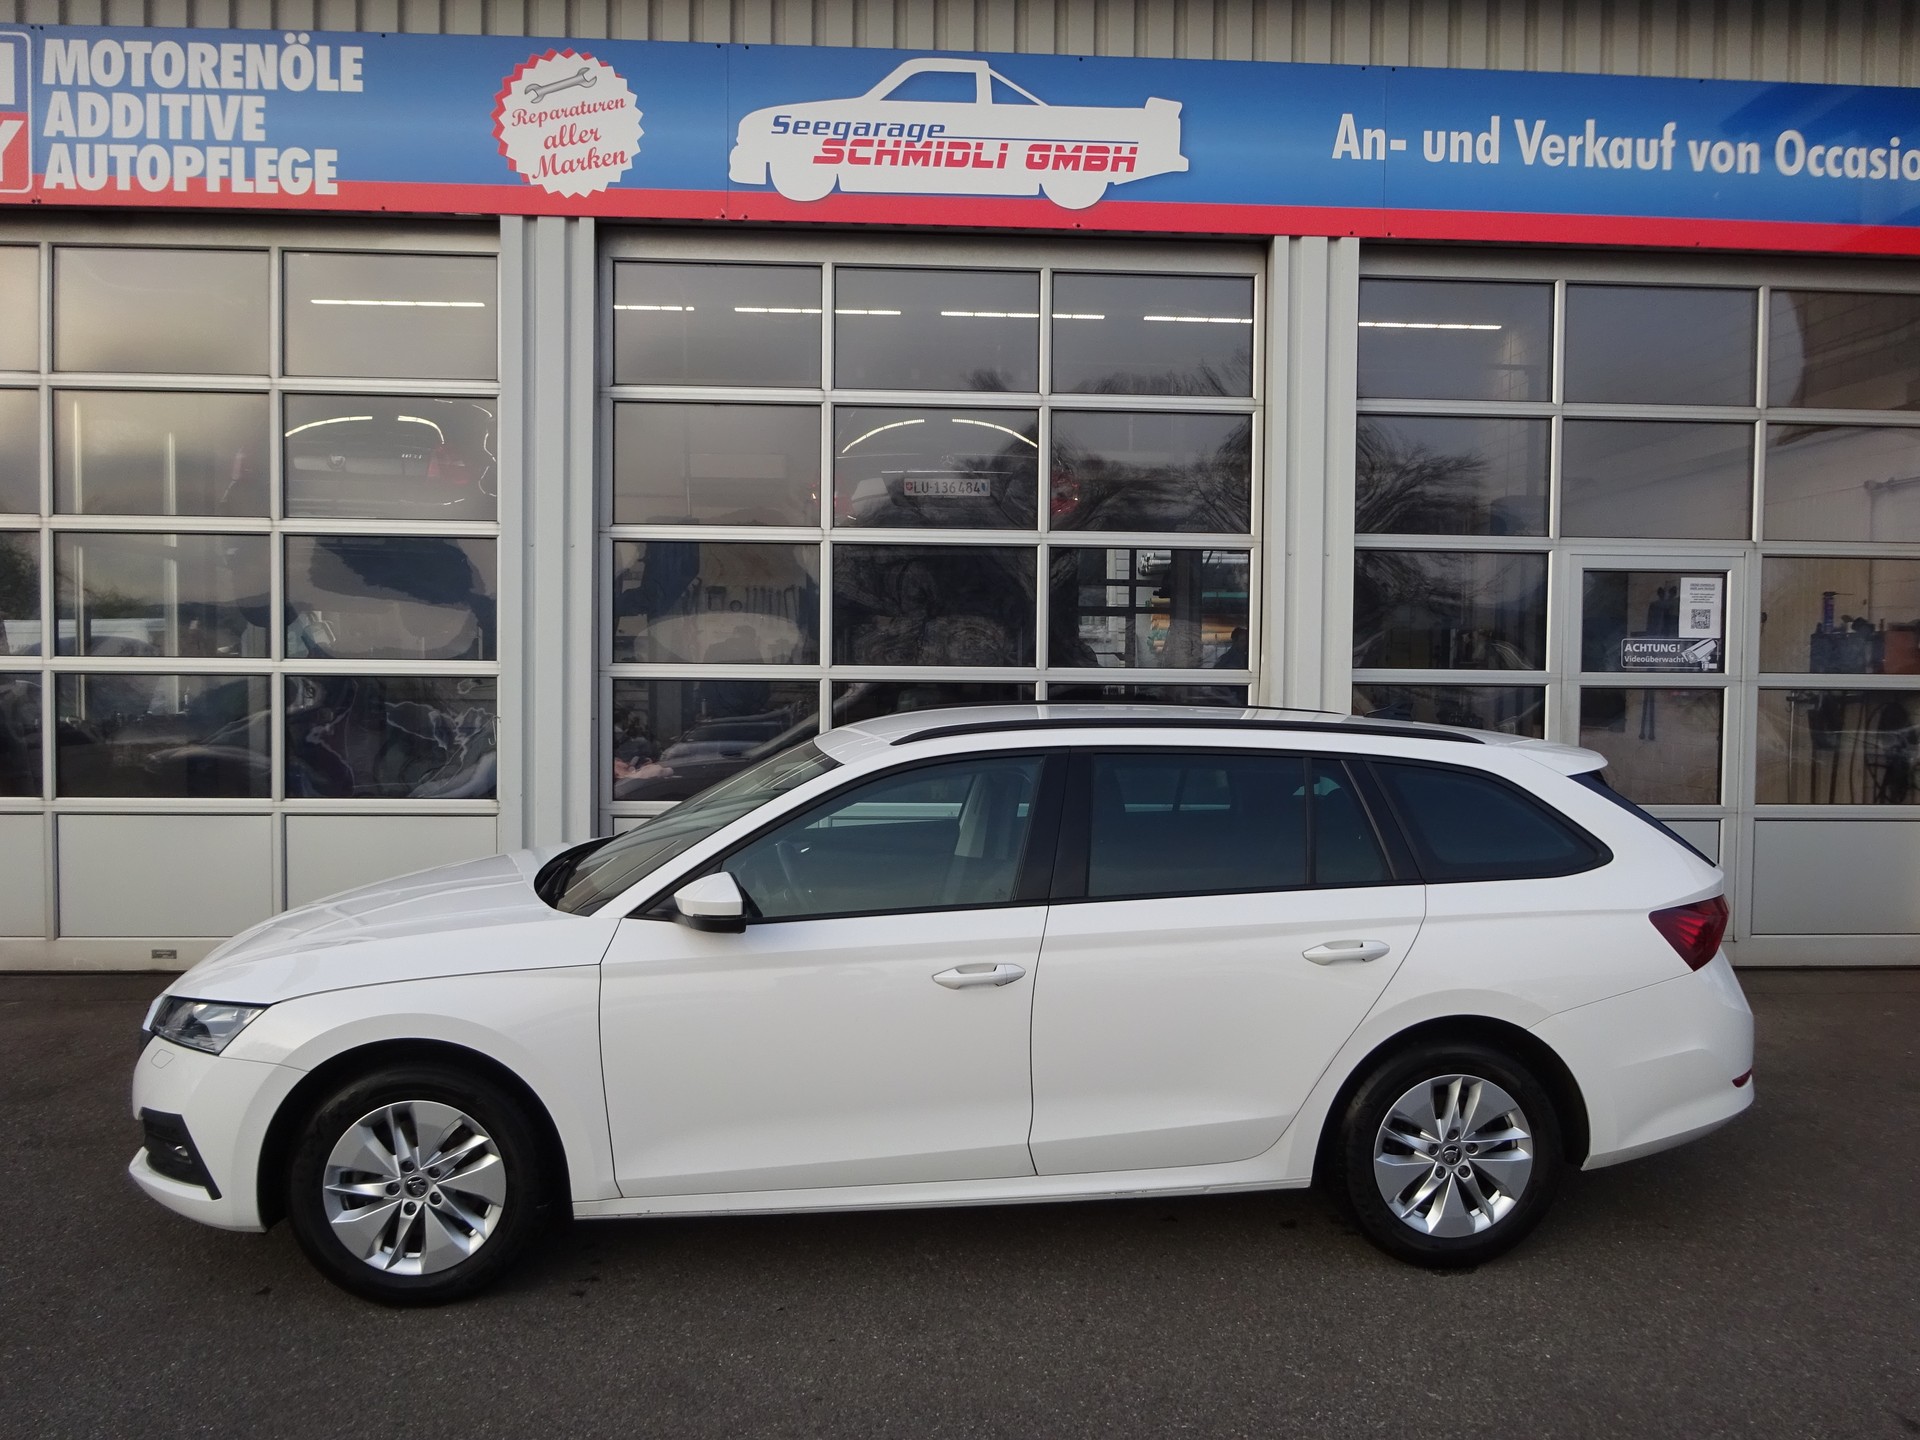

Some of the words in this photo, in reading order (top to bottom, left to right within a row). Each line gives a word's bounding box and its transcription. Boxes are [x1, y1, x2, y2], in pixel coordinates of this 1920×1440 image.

[42, 33, 363, 92] MOTORENÖLE
[43, 91, 265, 141] ADDITIVE
[511, 98, 626, 128] Reparaturen
[771, 115, 945, 141] Seegarage
[543, 122, 601, 150] aller
[1332, 113, 1407, 161] An-
[1423, 115, 1500, 164] und
[1514, 119, 1676, 171] Verkauf
[1688, 139, 1760, 174] von
[43, 143, 338, 195] AUTOPFLEGE
[531, 146, 628, 179] Marken
[1025, 144, 1138, 173] GMBH
[1624, 643, 1681, 653] ACHTUNG!
[1624, 655, 1684, 663] Videoüberwacht
